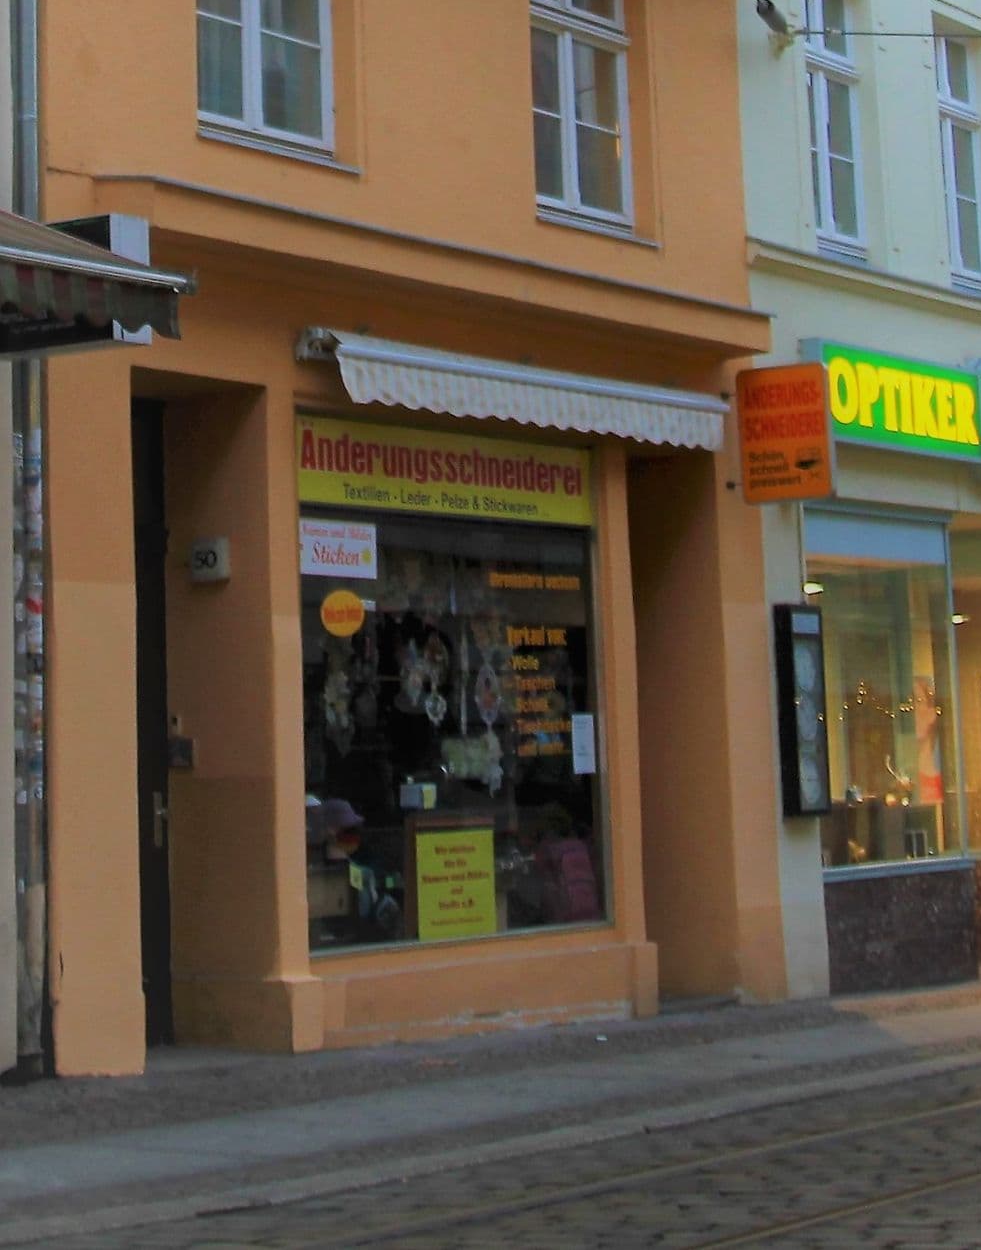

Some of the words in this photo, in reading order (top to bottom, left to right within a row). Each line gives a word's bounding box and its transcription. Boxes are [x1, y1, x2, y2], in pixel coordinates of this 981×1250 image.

[828, 356, 979, 446] OPTIKER
[301, 419, 582, 496] Änderungsschneiderei
[343, 482, 390, 502] Textilien
[400, 488, 432, 506] Leder
[441, 493, 469, 510] Pelze
[311, 541, 360, 567] Sticken
